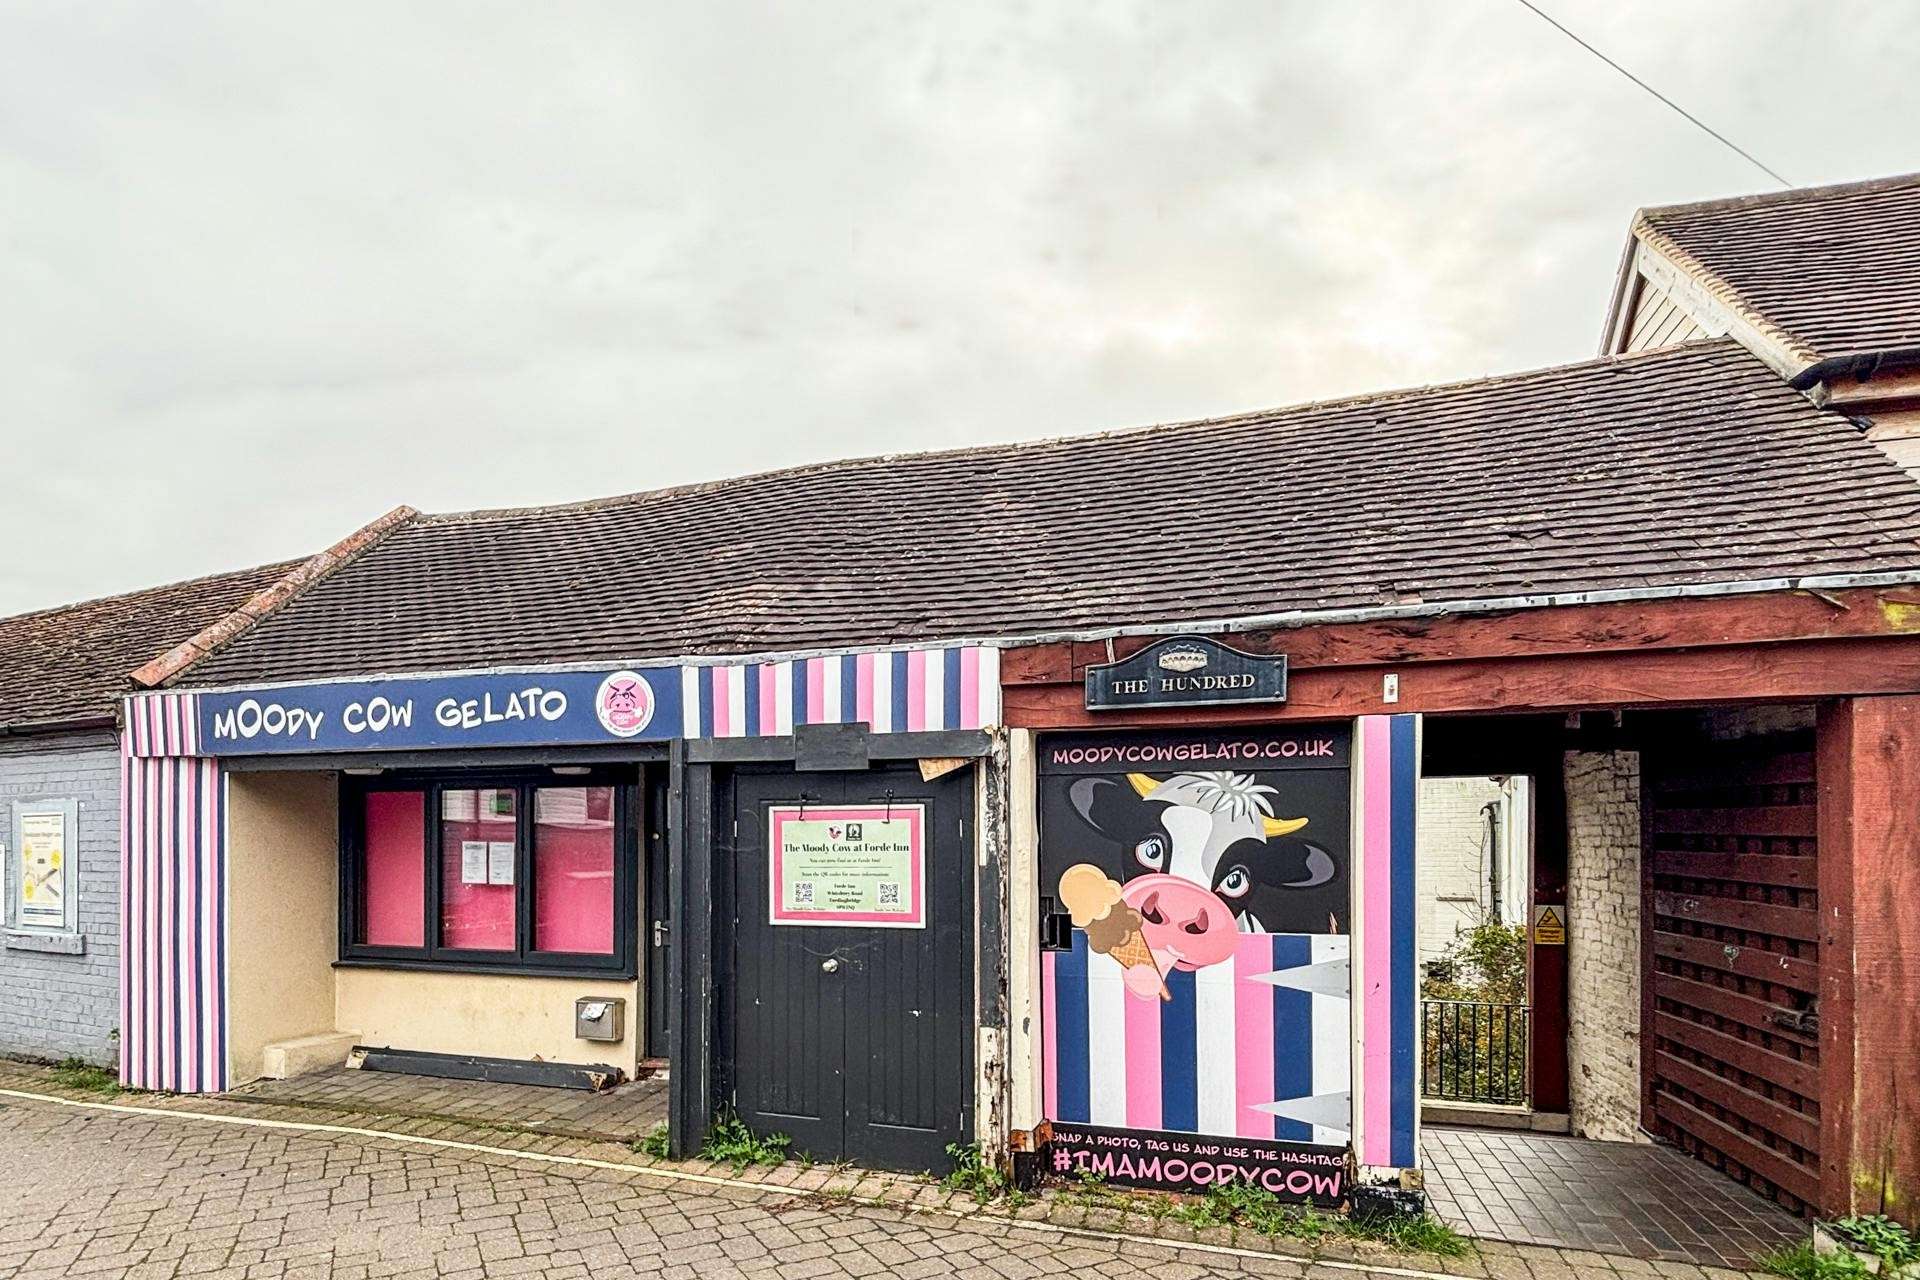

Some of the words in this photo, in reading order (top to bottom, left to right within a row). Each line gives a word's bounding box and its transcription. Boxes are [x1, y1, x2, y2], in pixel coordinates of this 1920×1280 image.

[1112, 680, 1148, 695] THE
[1161, 674, 1256, 692] HUNDRED
[214, 699, 323, 740] MOODY
[343, 696, 413, 734] COW
[435, 687, 567, 729] GELATO
[1053, 740, 1334, 764] MOODYCOWGELATO.CO.UK
[784, 843, 800, 852] The
[802, 843, 829, 855] Moody
[865, 843, 891, 852] Forde
[893, 843, 909, 852] Inn
[1053, 1132, 1082, 1143] SNAP
[1085, 1136, 1094, 1145] A
[1097, 1136, 1141, 1150] PHOTO,
[1145, 1140, 1169, 1151] TAG
[1173, 1143, 1190, 1152] US
[1194, 1144, 1220, 1155] AND
[1224, 1148, 1249, 1158] USE
[1253, 1149, 1279, 1161] THE
[1282, 1152, 1343, 1167] HASHTAG
[1053, 1147, 1342, 1197] #IMAMOODYCOW
